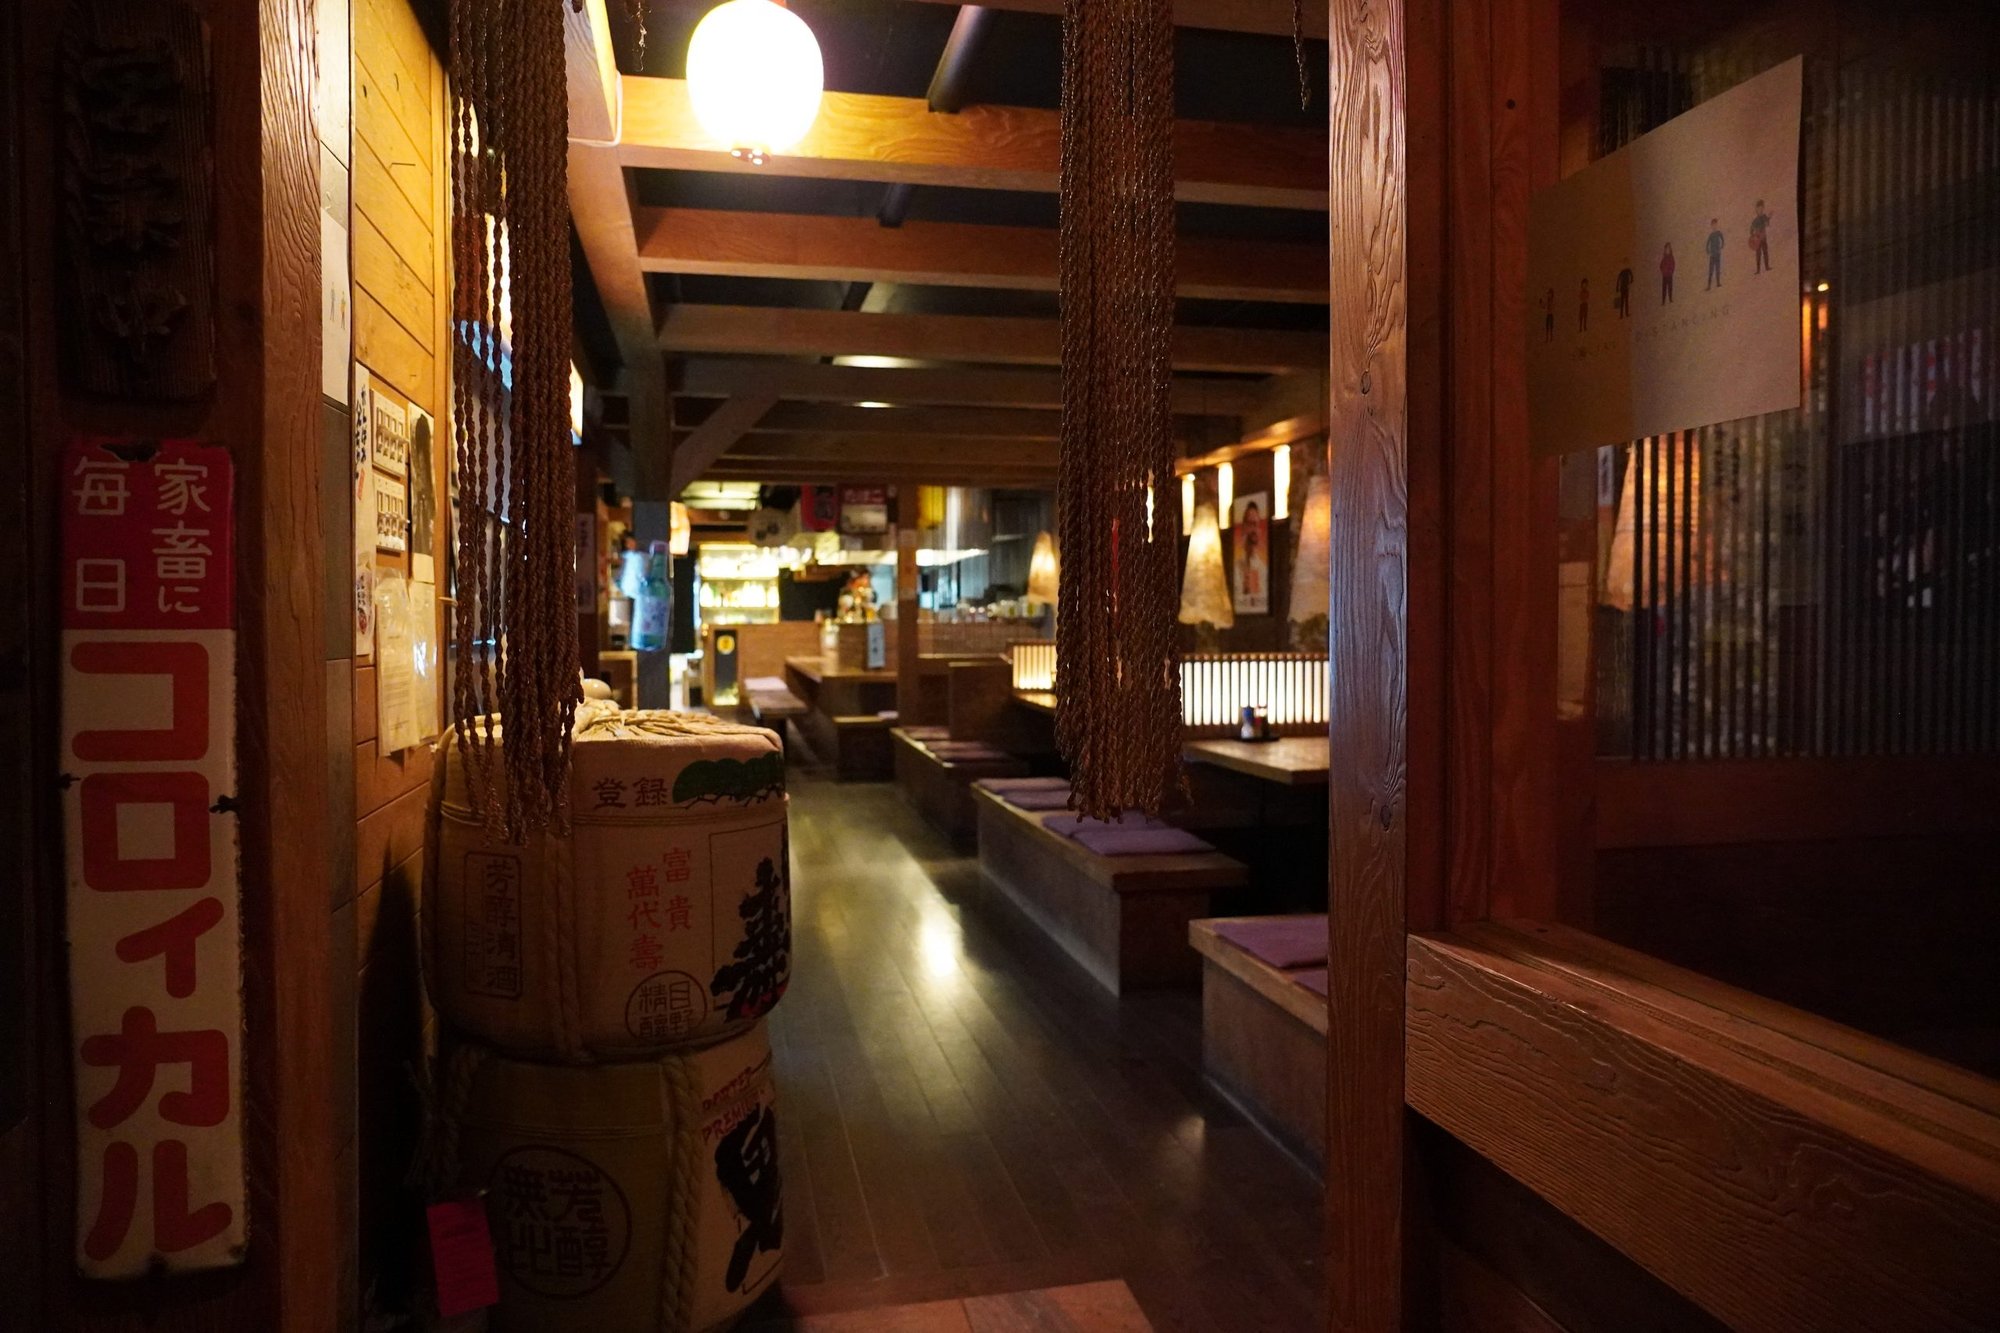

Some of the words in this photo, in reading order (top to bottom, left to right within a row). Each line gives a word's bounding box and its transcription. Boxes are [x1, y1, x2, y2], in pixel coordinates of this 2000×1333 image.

[73, 457, 131, 614] 毎日
[153, 458, 213, 614] 家畜に
[593, 777, 668, 810] 登録
